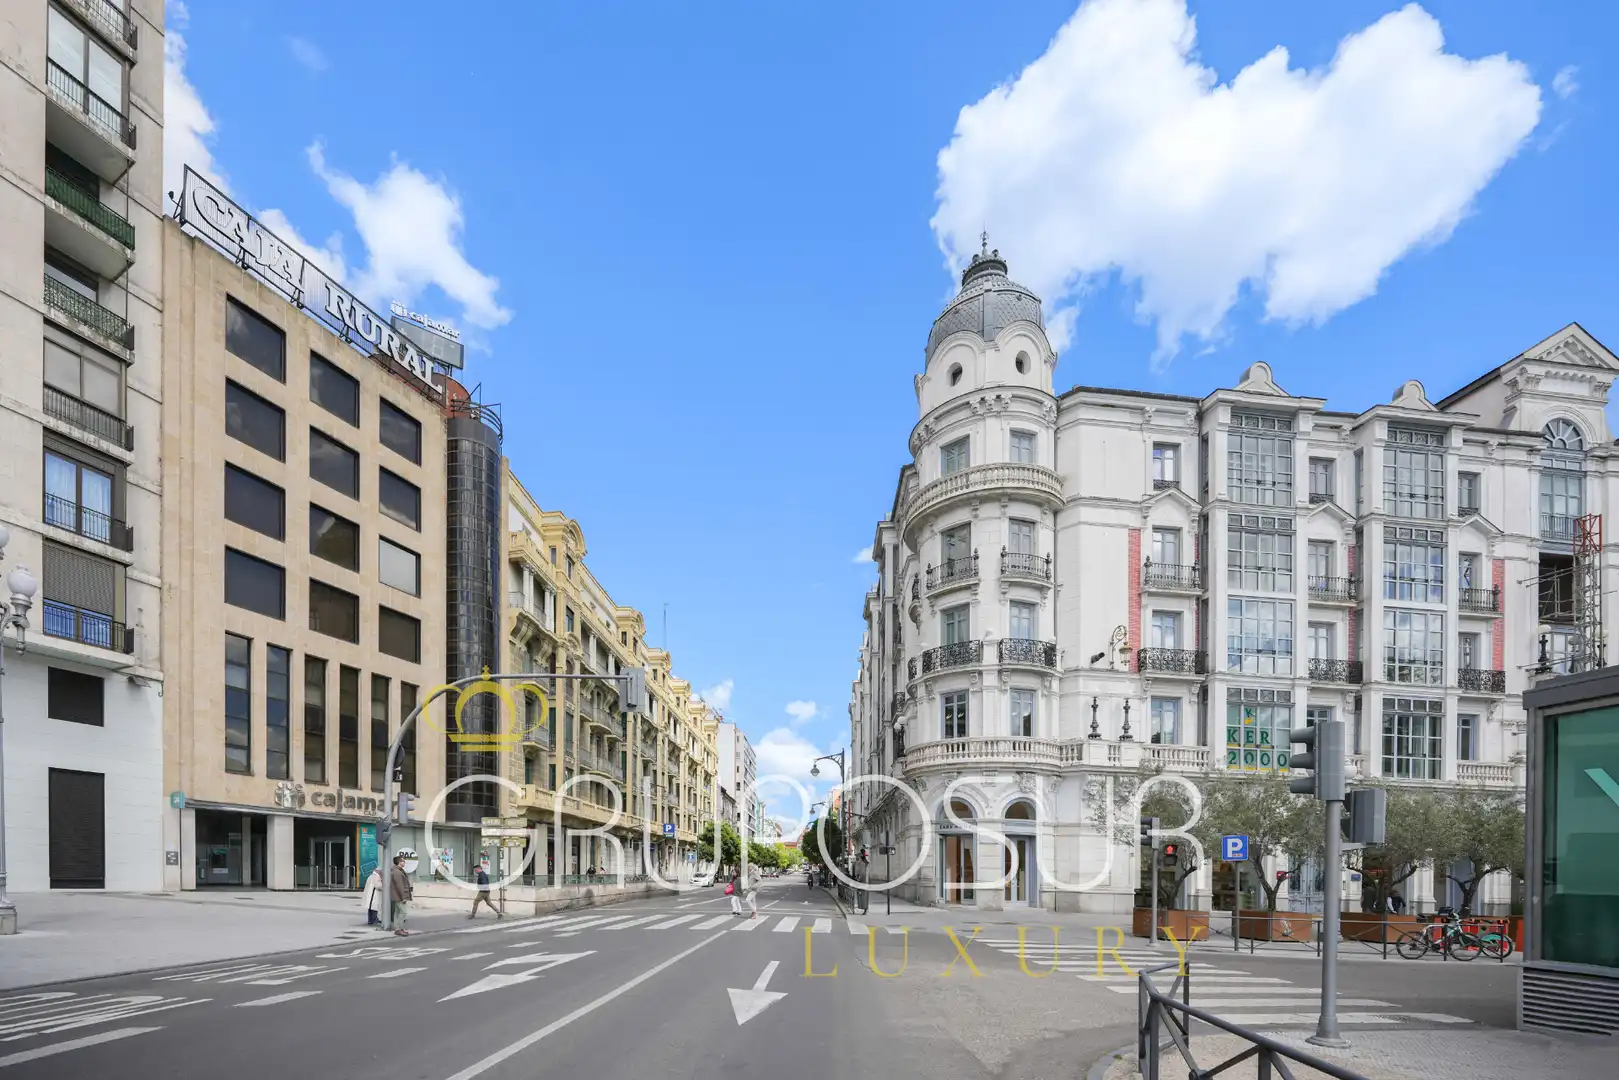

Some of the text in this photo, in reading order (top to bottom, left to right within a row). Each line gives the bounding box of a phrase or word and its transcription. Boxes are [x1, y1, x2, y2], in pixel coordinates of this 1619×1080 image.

[193, 186, 443, 394] CAJA RURAL
[1227, 728, 1270, 745] KER
[1228, 750, 1288, 767] 2000
[1227, 838, 1243, 858] P
